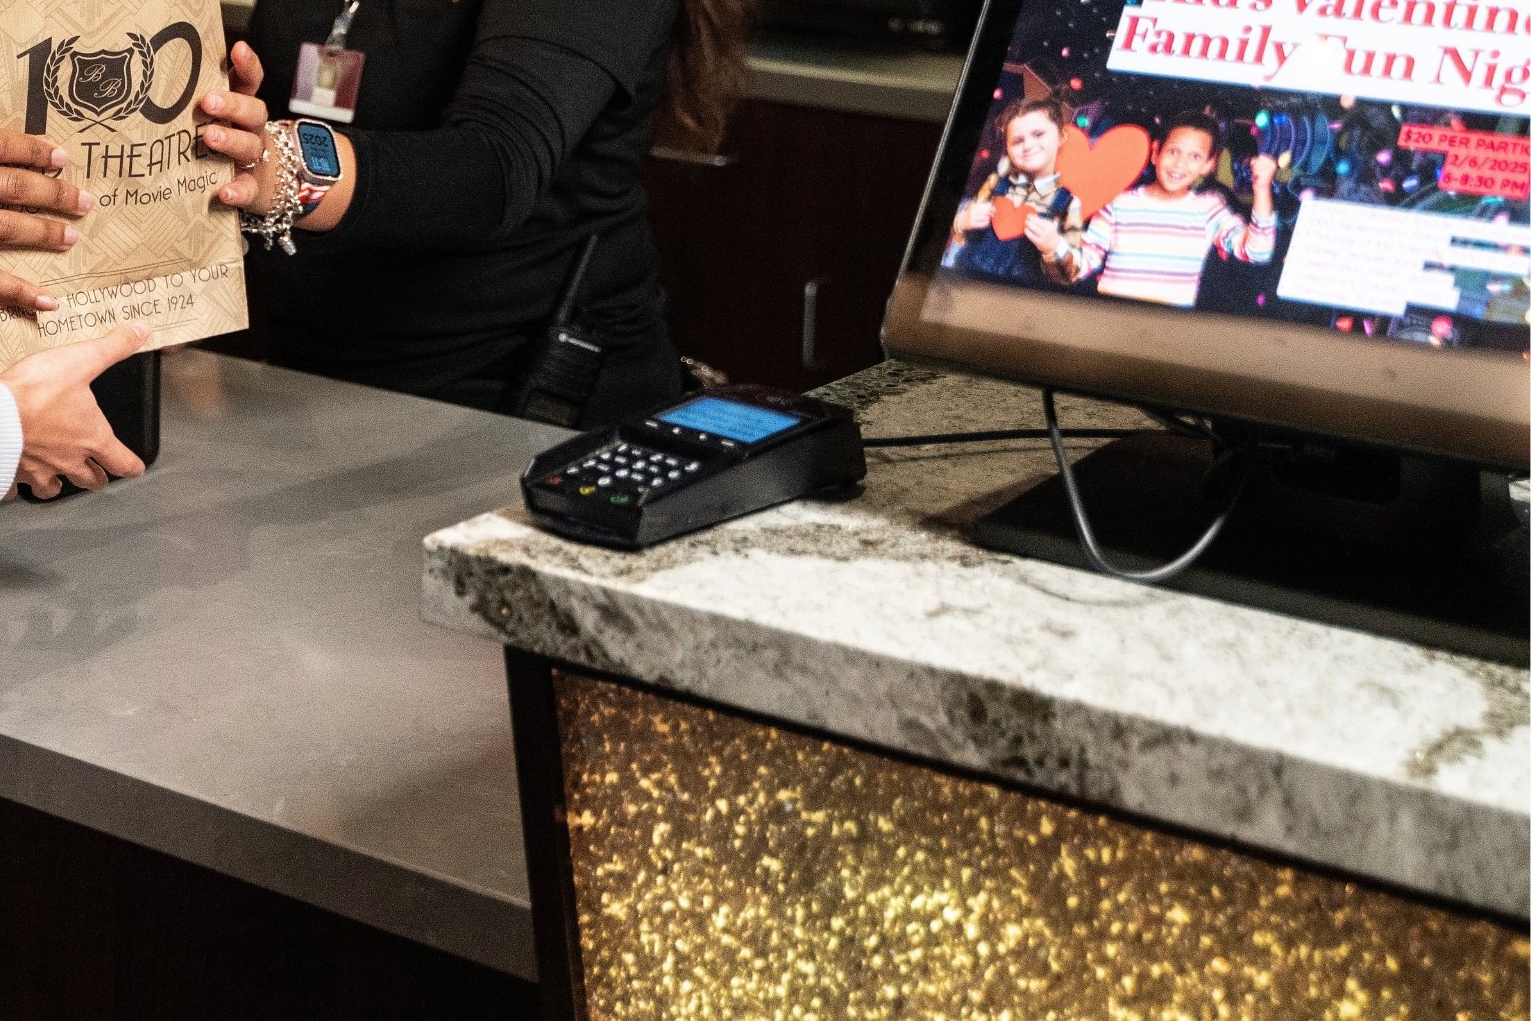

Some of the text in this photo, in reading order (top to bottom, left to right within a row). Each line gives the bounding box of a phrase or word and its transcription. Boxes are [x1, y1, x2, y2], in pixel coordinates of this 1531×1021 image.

[1116, 14, 1301, 82] Family
[80, 121, 208, 179] THEATRE
[1404, 129, 1433, 144] $20
[1438, 134, 1470, 148] PER
[99, 170, 218, 207] of Movie Magic
[1499, 178, 1526, 193] PM
[67, 278, 157, 309] HOLLYWOOD
[164, 273, 183, 289] TO
[189, 264, 229, 284] YOUR
[37, 294, 195, 338] HOMETOWN SINCE 1924
